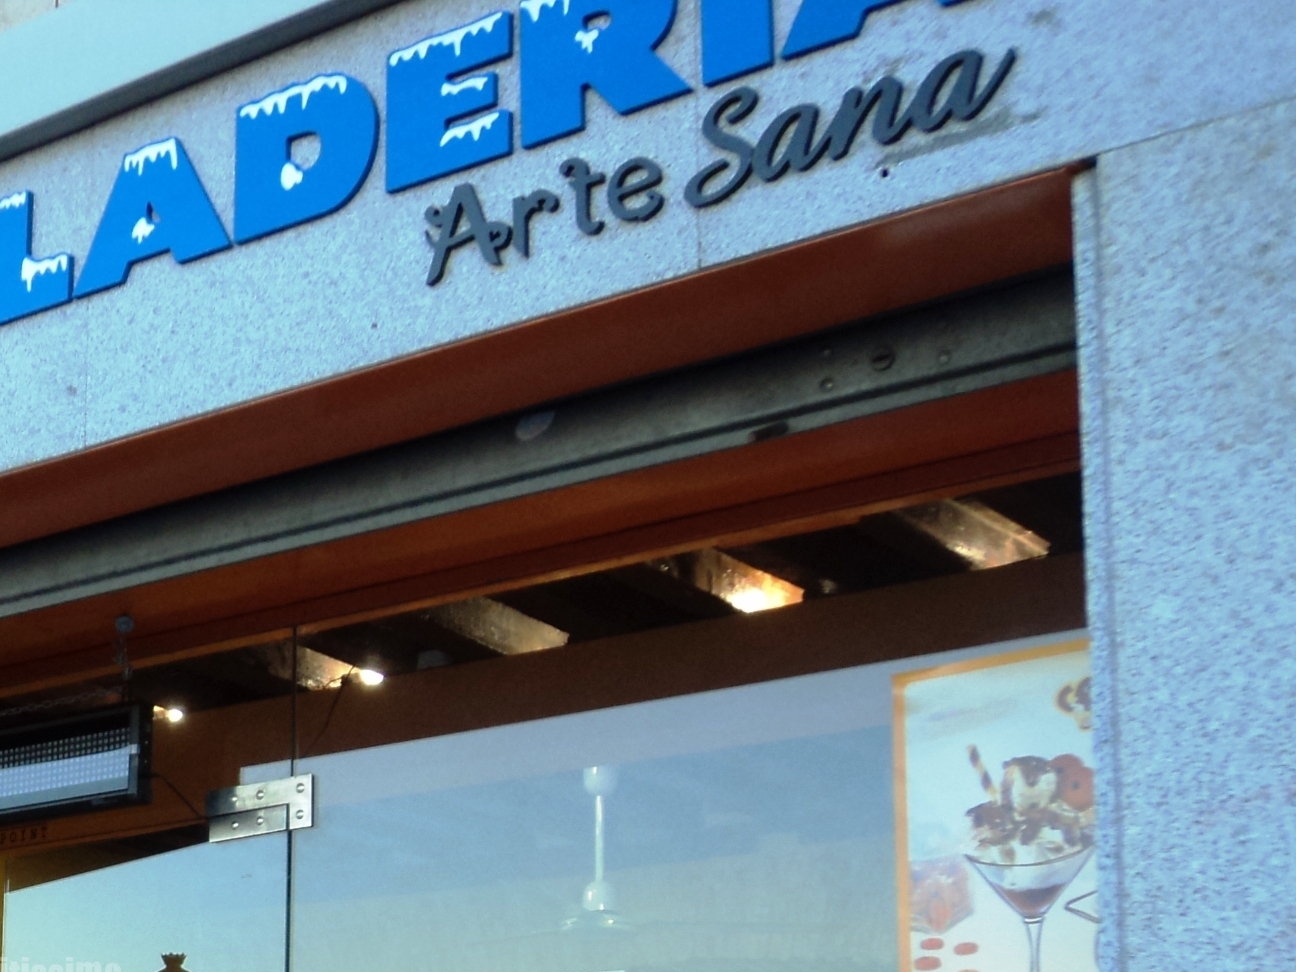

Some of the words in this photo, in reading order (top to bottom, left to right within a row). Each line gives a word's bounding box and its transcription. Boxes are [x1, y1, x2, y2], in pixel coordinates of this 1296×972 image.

[425, 156, 665, 287] Arte
[684, 46, 1018, 210] Sana
[0, 826, 48, 845] POINT
